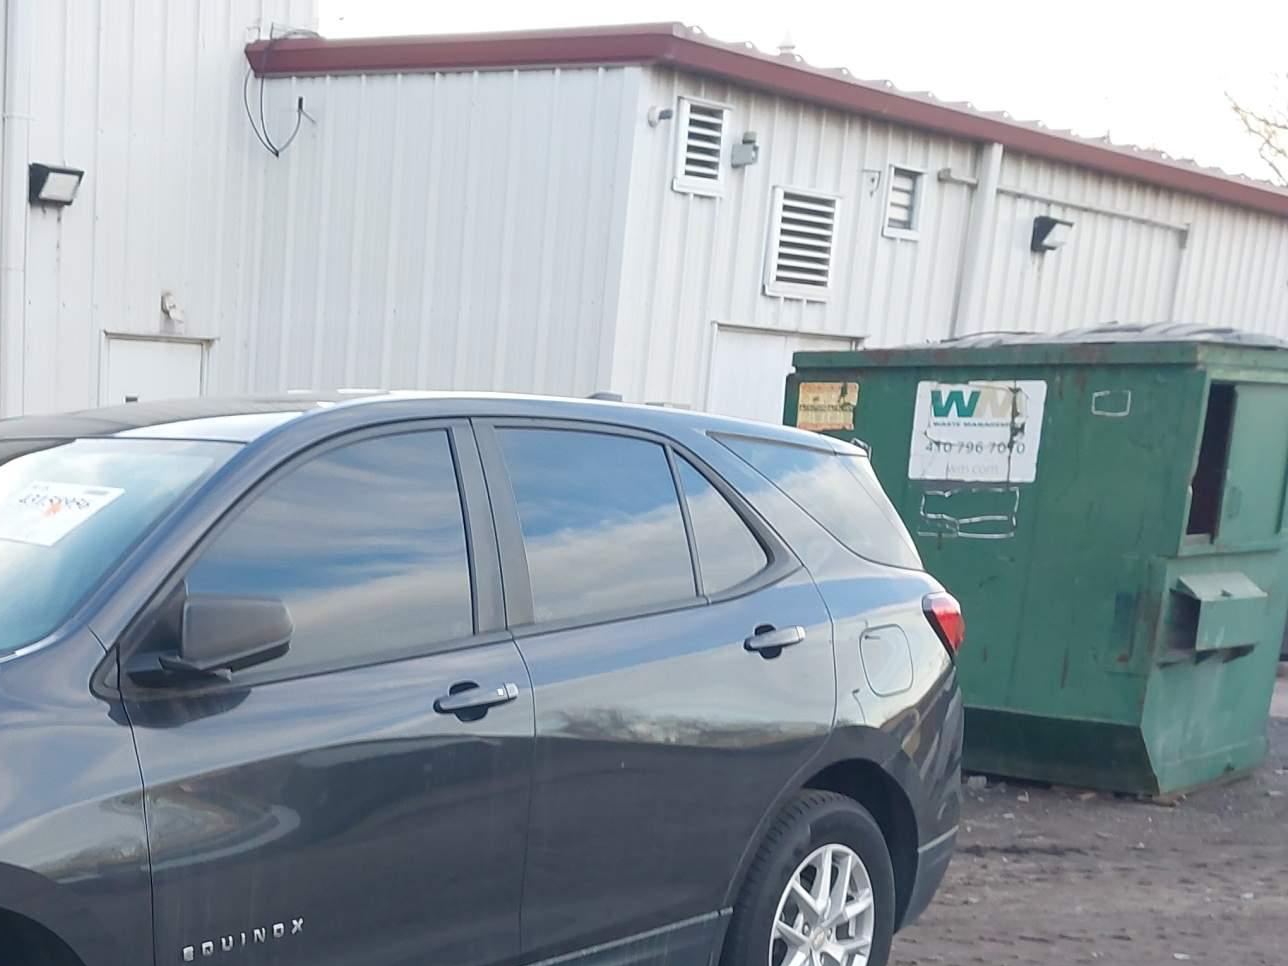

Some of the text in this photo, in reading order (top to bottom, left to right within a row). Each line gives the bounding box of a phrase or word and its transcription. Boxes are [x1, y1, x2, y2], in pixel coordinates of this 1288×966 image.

[931, 390, 1028, 418] WM
[958, 442, 983, 453] 796
[991, 442, 1025, 454] 700
[182, 917, 304, 961] EQUINOX
